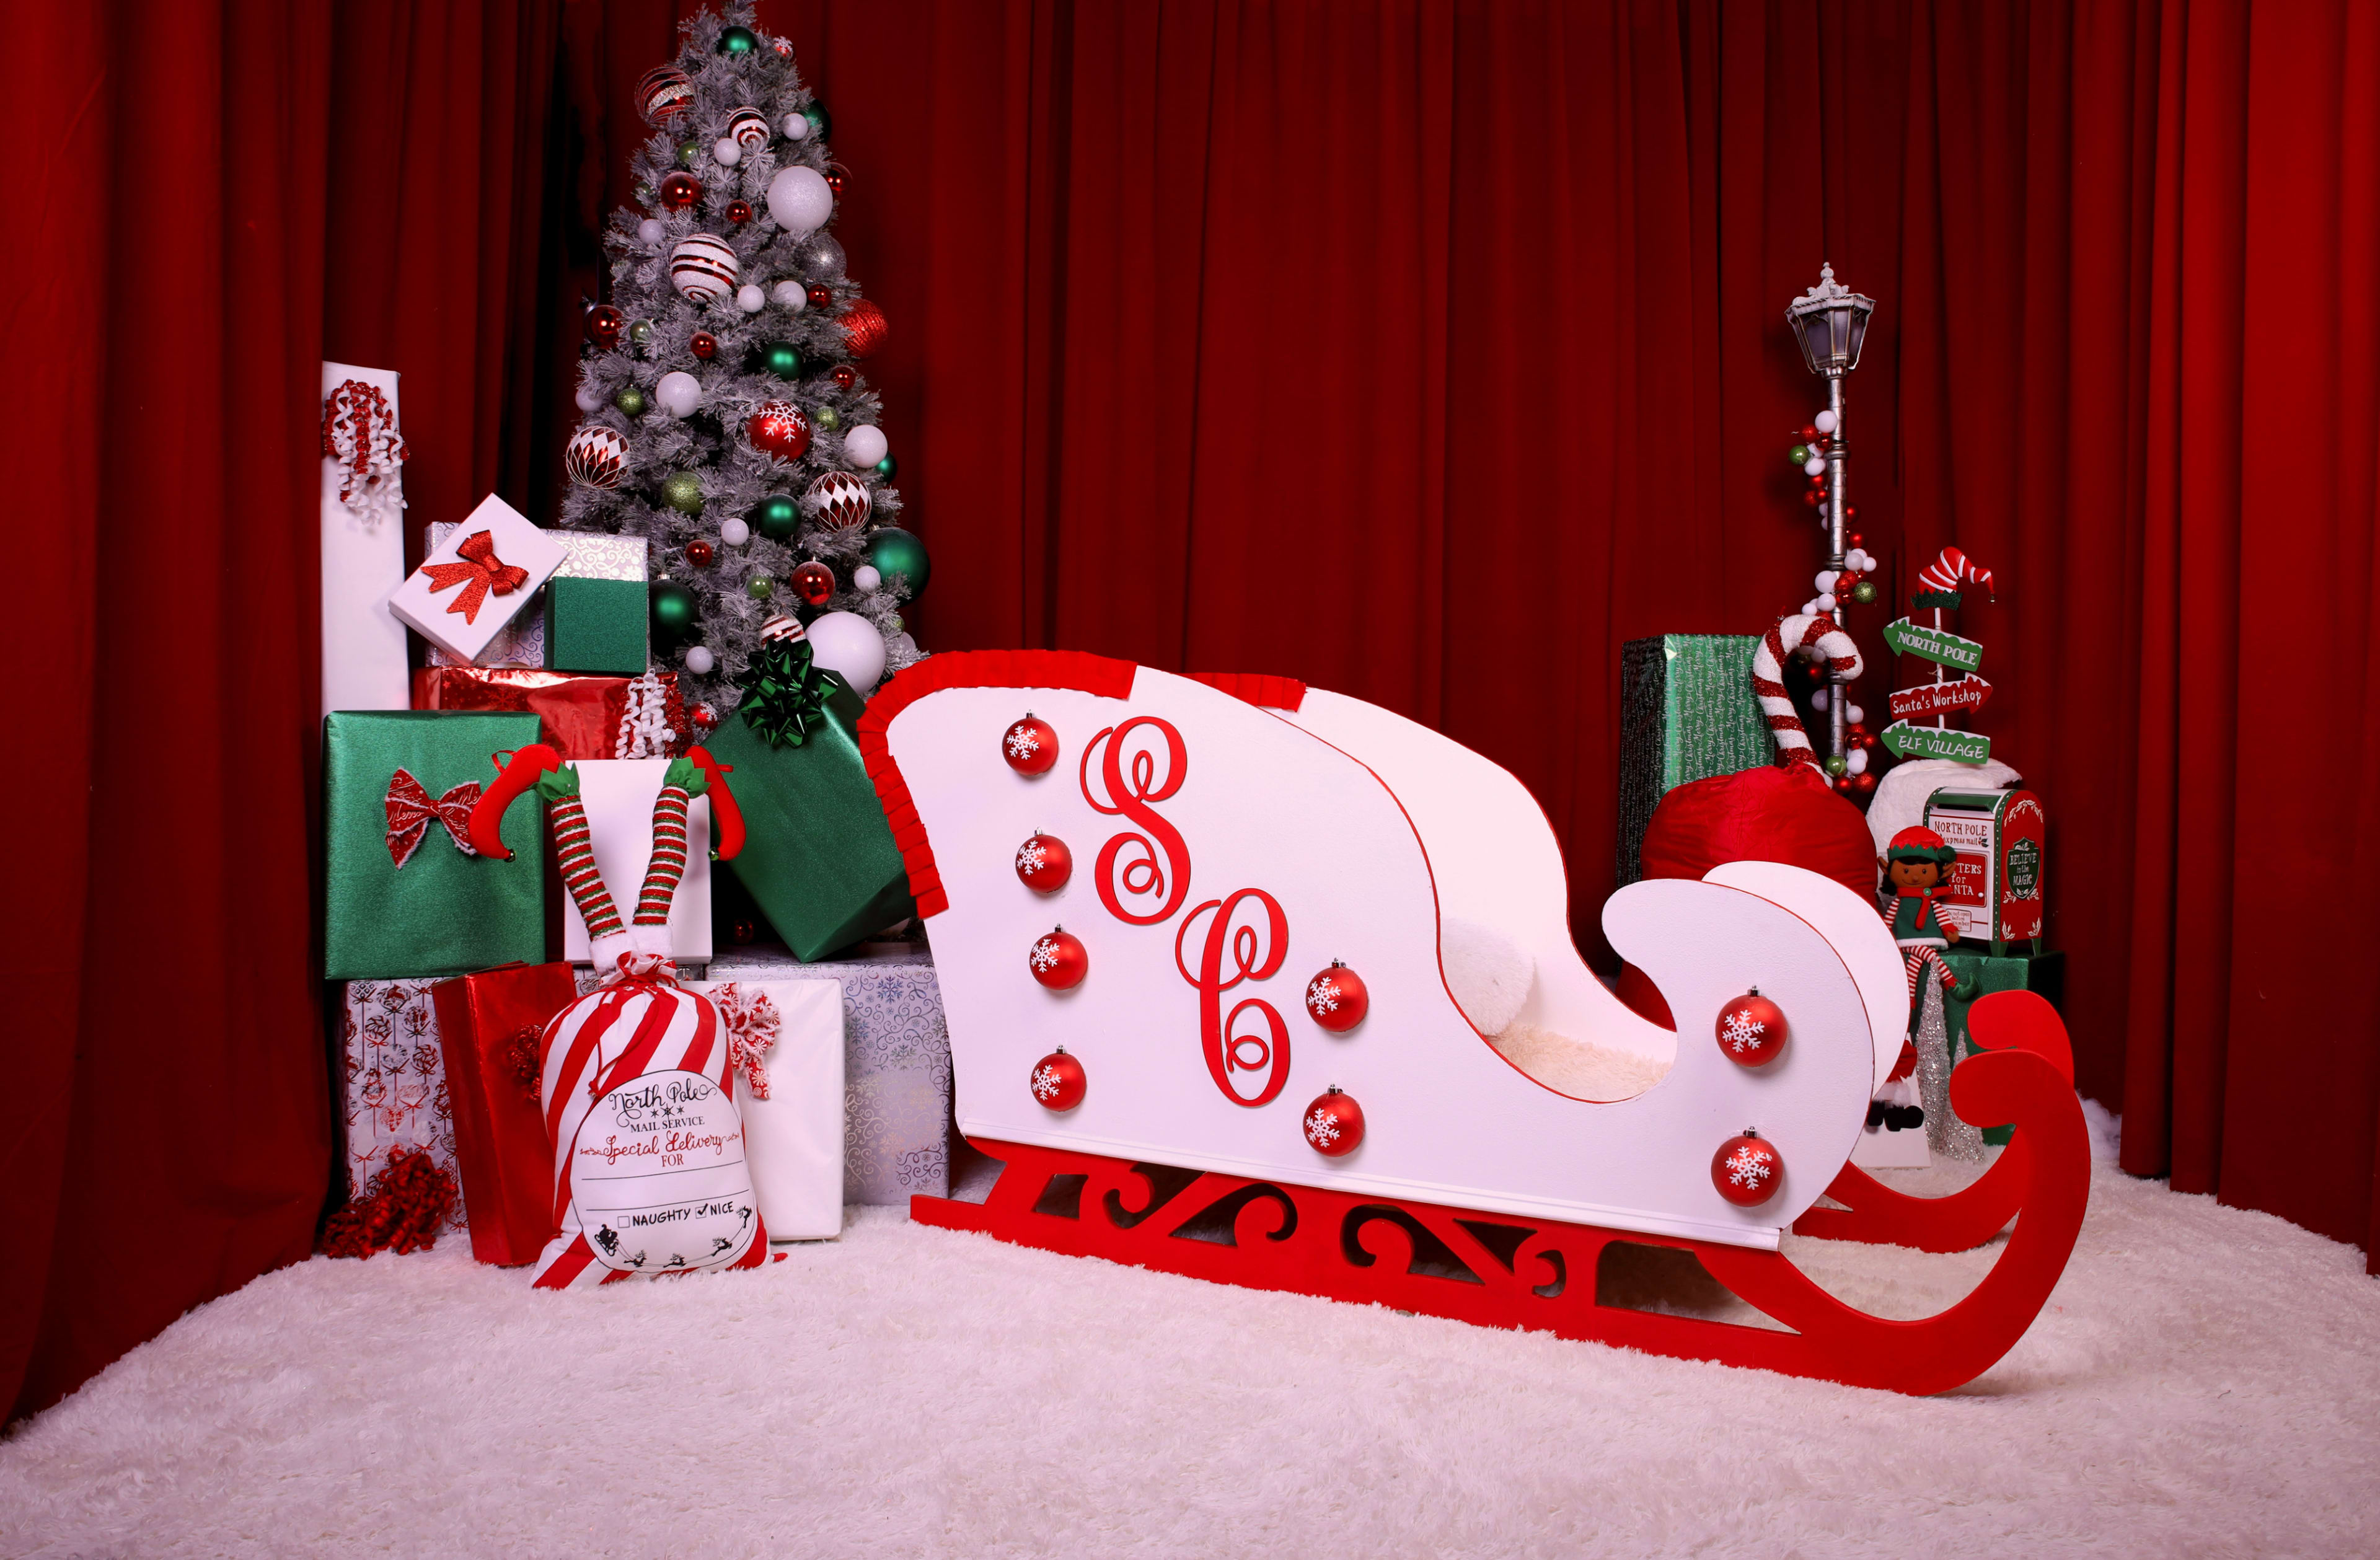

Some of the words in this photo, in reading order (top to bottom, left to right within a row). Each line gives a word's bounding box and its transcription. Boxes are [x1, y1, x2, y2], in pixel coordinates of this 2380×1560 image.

[1693, 647, 1704, 675] Merry
[1726, 635, 1735, 663] Merry
[1735, 645, 1745, 681] Christmas
[1897, 632, 1941, 654] NORTH
[1942, 644, 1978, 666] POLE
[1683, 656, 1693, 692] Christmas
[1706, 668, 1716, 695] Merry
[1716, 654, 1727, 690] Christmas
[1725, 668, 1735, 703] Christmas
[1683, 693, 1694, 721] Merry
[1694, 678, 1704, 714] Christmas
[1715, 690, 1725, 718] Merry
[1737, 682, 1746, 710] Merry
[1893, 695, 1930, 714] Santa's
[1933, 688, 1981, 706] Workshop
[1704, 698, 1715, 736] Christmas
[1726, 703, 1736, 733] Merry
[1745, 700, 1755, 728] Merry
[1756, 710, 1766, 746] Christmas
[1683, 725, 1693, 762] Christmas
[1694, 716, 1704, 744] Merry
[1716, 723, 1726, 760] Christmas
[1736, 714, 1745, 750] Christmas
[1705, 736, 1715, 765] Merry
[1726, 736, 1735, 772] Christmas
[1747, 733, 1756, 769] Christmas
[1898, 735, 1923, 750] ELF
[1926, 739, 1984, 759] VILLAGE
[1694, 747, 1704, 780] hristmas
[1080, 716, 1191, 925] S
[1935, 821, 1962, 835] NORTH
[1965, 824, 1987, 836] POLE
[1957, 863, 1981, 875] TERS
[2009, 853, 2037, 865] BELIEVE
[1951, 871, 1966, 884] for
[1954, 885, 1973, 896] NTA
[2013, 874, 2032, 886] MAGIC
[609, 1084, 666, 1127] North
[666, 1078, 717, 1103] Pole
[630, 1122, 660, 1133] MAIL
[662, 1116, 705, 1129] SERVICE
[603, 1135, 659, 1165] Special
[661, 1153, 684, 1167] FOR
[633, 1208, 690, 1226] NAUGHTY
[710, 1201, 734, 1215] NICE
